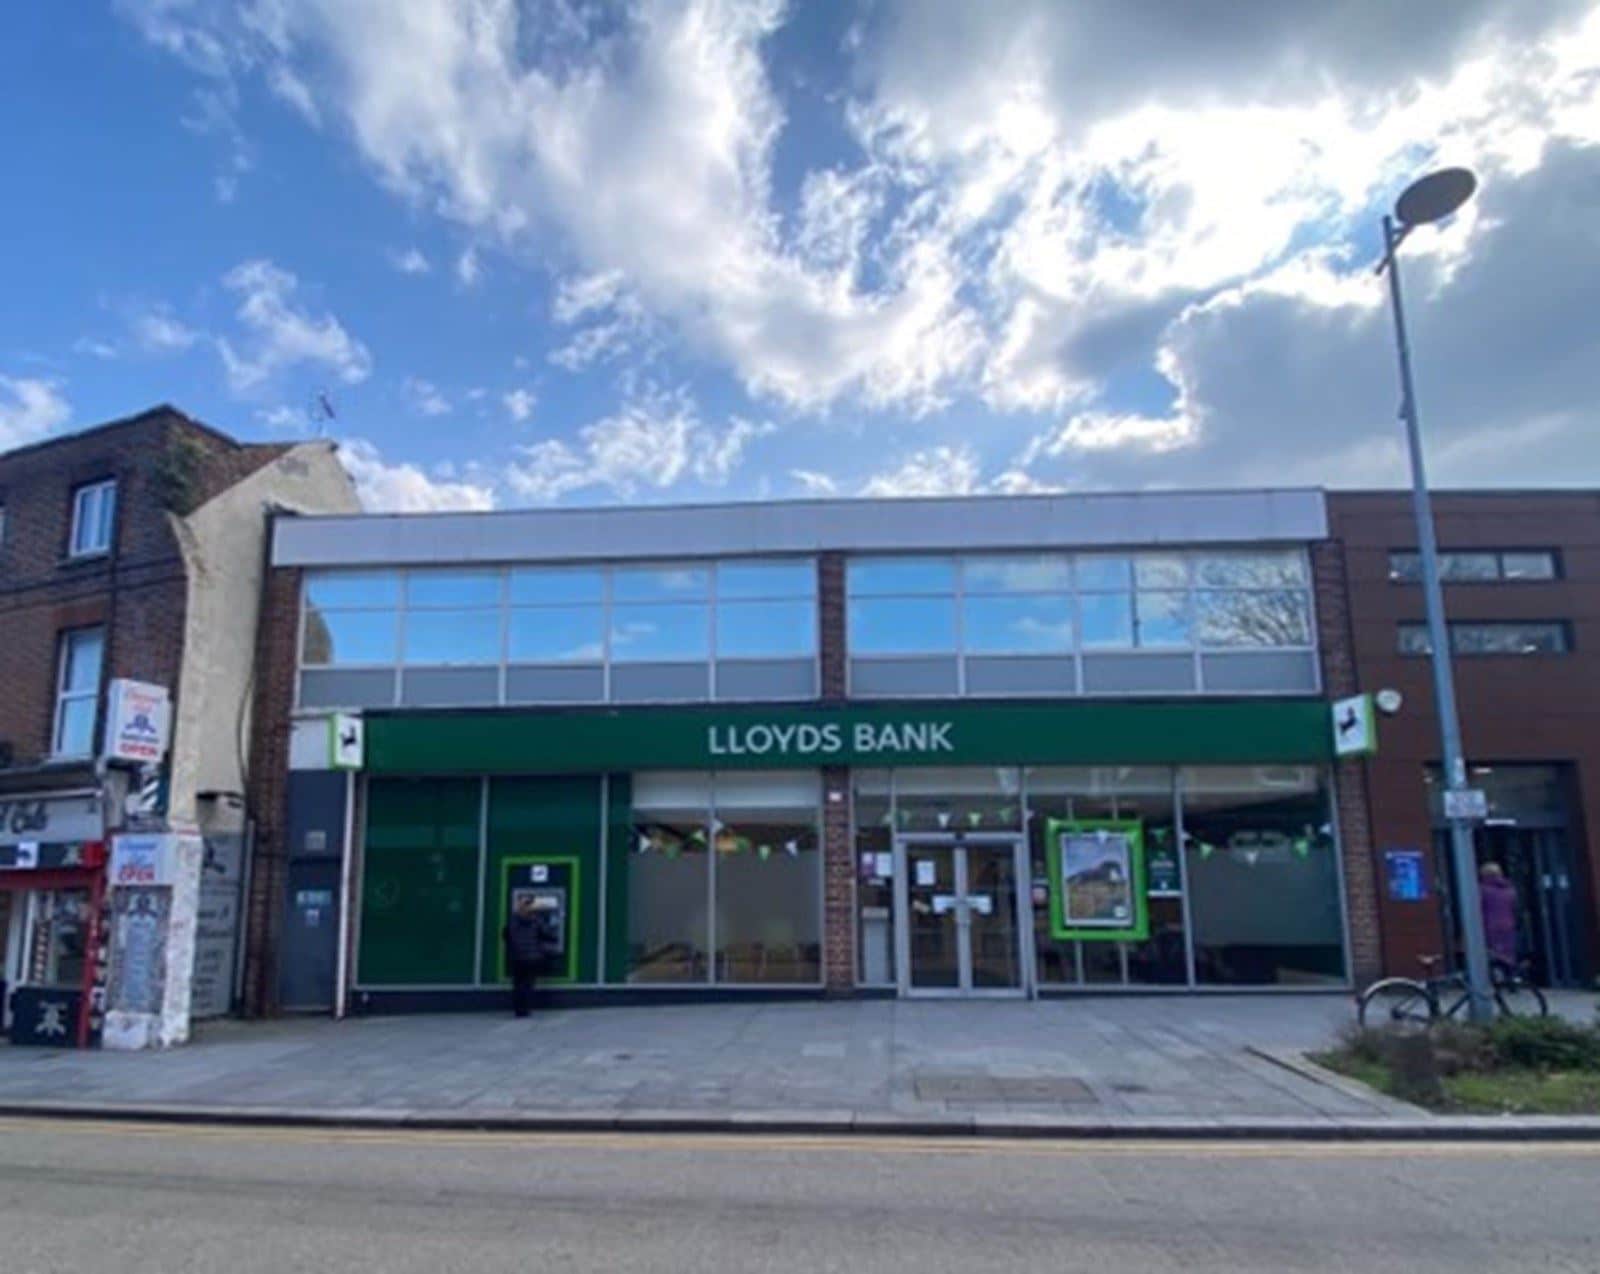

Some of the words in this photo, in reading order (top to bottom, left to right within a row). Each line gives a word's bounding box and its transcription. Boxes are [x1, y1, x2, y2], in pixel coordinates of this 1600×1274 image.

[708, 724, 842, 754] LLOYDS
[854, 722, 954, 752] BANK
[119, 867, 155, 881] OPEN
